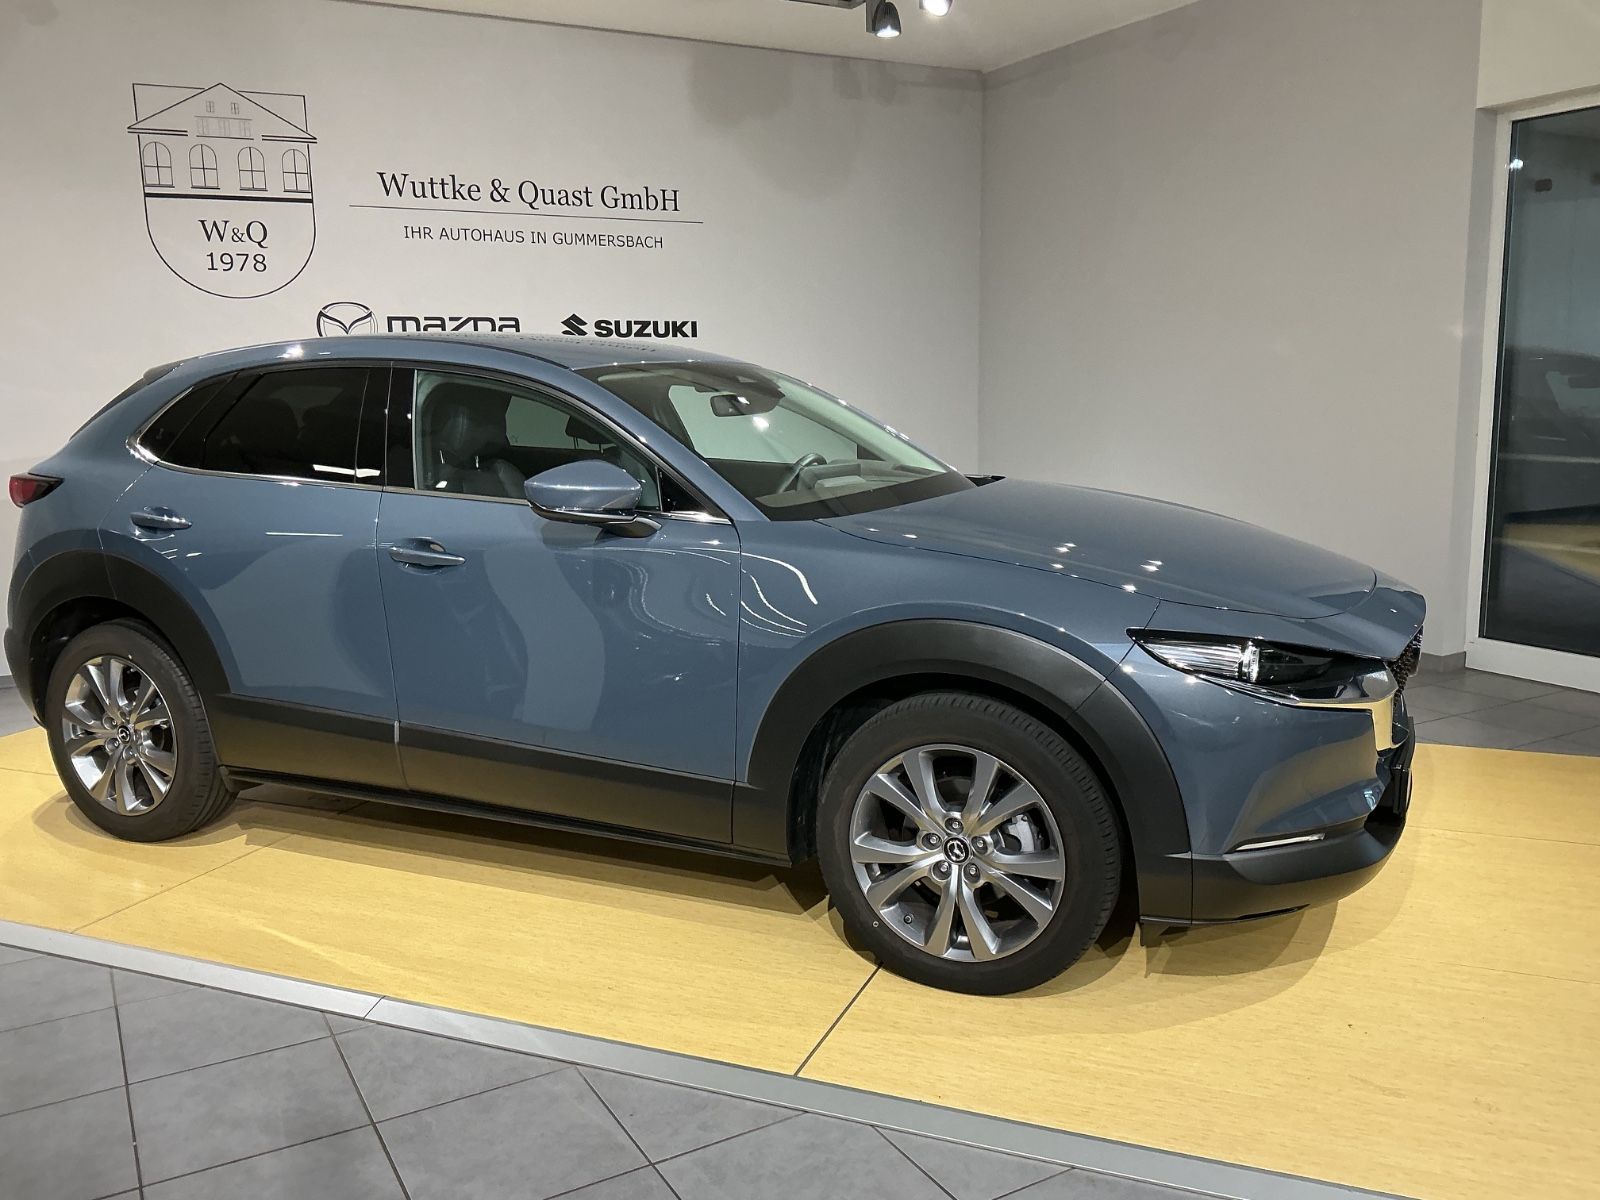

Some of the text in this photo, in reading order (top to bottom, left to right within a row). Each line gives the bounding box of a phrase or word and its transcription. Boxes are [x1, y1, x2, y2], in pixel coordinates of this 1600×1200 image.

[375, 171, 681, 212] Wuttke & Quast GmbH
[197, 219, 269, 249] W&Q
[403, 225, 663, 249] IHR AUTOHAUS IN GUMMERSBACH
[206, 251, 267, 273] 1978
[593, 319, 698, 339] SUZUKI
